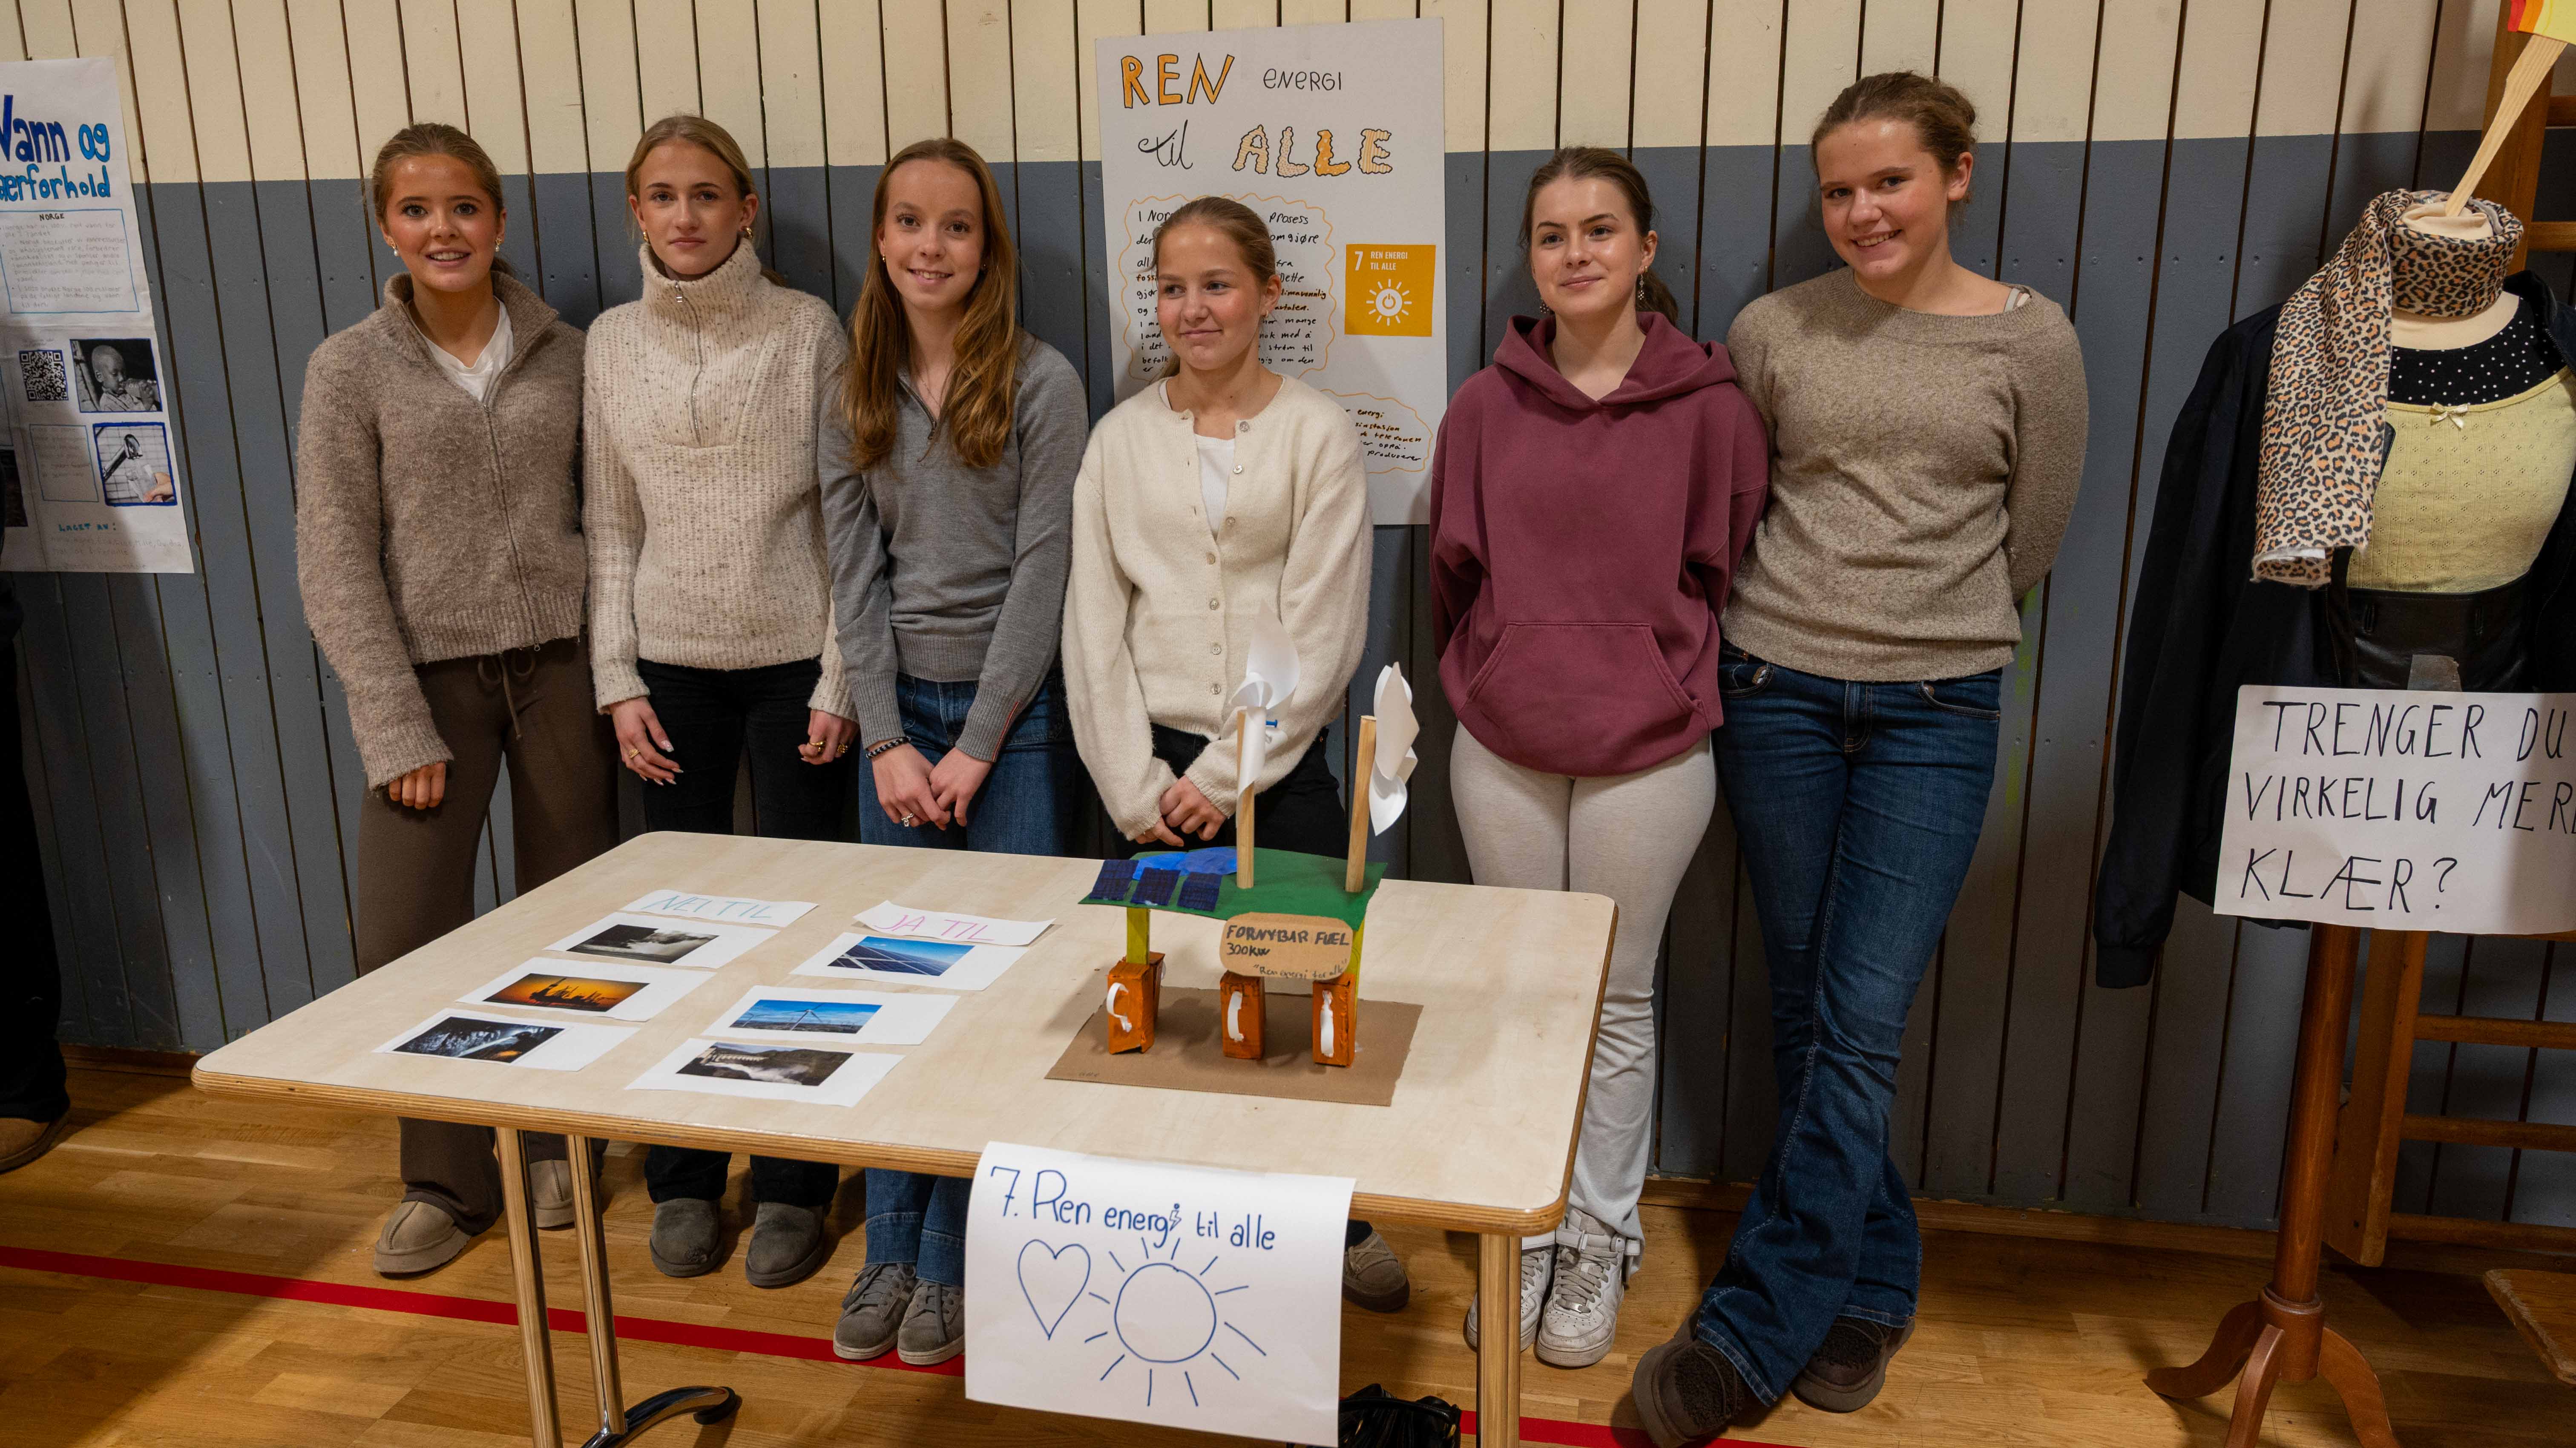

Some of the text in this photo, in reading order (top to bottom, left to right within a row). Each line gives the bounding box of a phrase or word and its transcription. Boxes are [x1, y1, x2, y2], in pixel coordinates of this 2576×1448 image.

[1121, 53, 1235, 109] REN
[78, 123, 110, 163] og
[1138, 120, 1393, 178] til ALLE
[40, 213, 65, 221] NORGE
[1147, 210, 1171, 223] Nor
[1355, 251, 1408, 271] 7 REN ENERGI
[1370, 262, 1396, 270] TIL ALLE
[1138, 308, 1148, 316] og
[1142, 356, 1168, 364] befolk
[1357, 409, 1384, 419] energi
[1367, 450, 1421, 461] produserer
[2263, 701, 2567, 761] TRENGER DU
[2245, 772, 2576, 834] VIRKELIG MER
[2241, 848, 2458, 913] KLÆR?
[640, 895, 773, 918] NEI TIL
[874, 914, 996, 941] JA TIL
[1226, 925, 1350, 946] FORNYBAR FUEL
[990, 1166, 1021, 1218] 7.
[1033, 1169, 1091, 1224] Ren
[1196, 1211, 1219, 1238] til
[1230, 1214, 1276, 1250] alle
